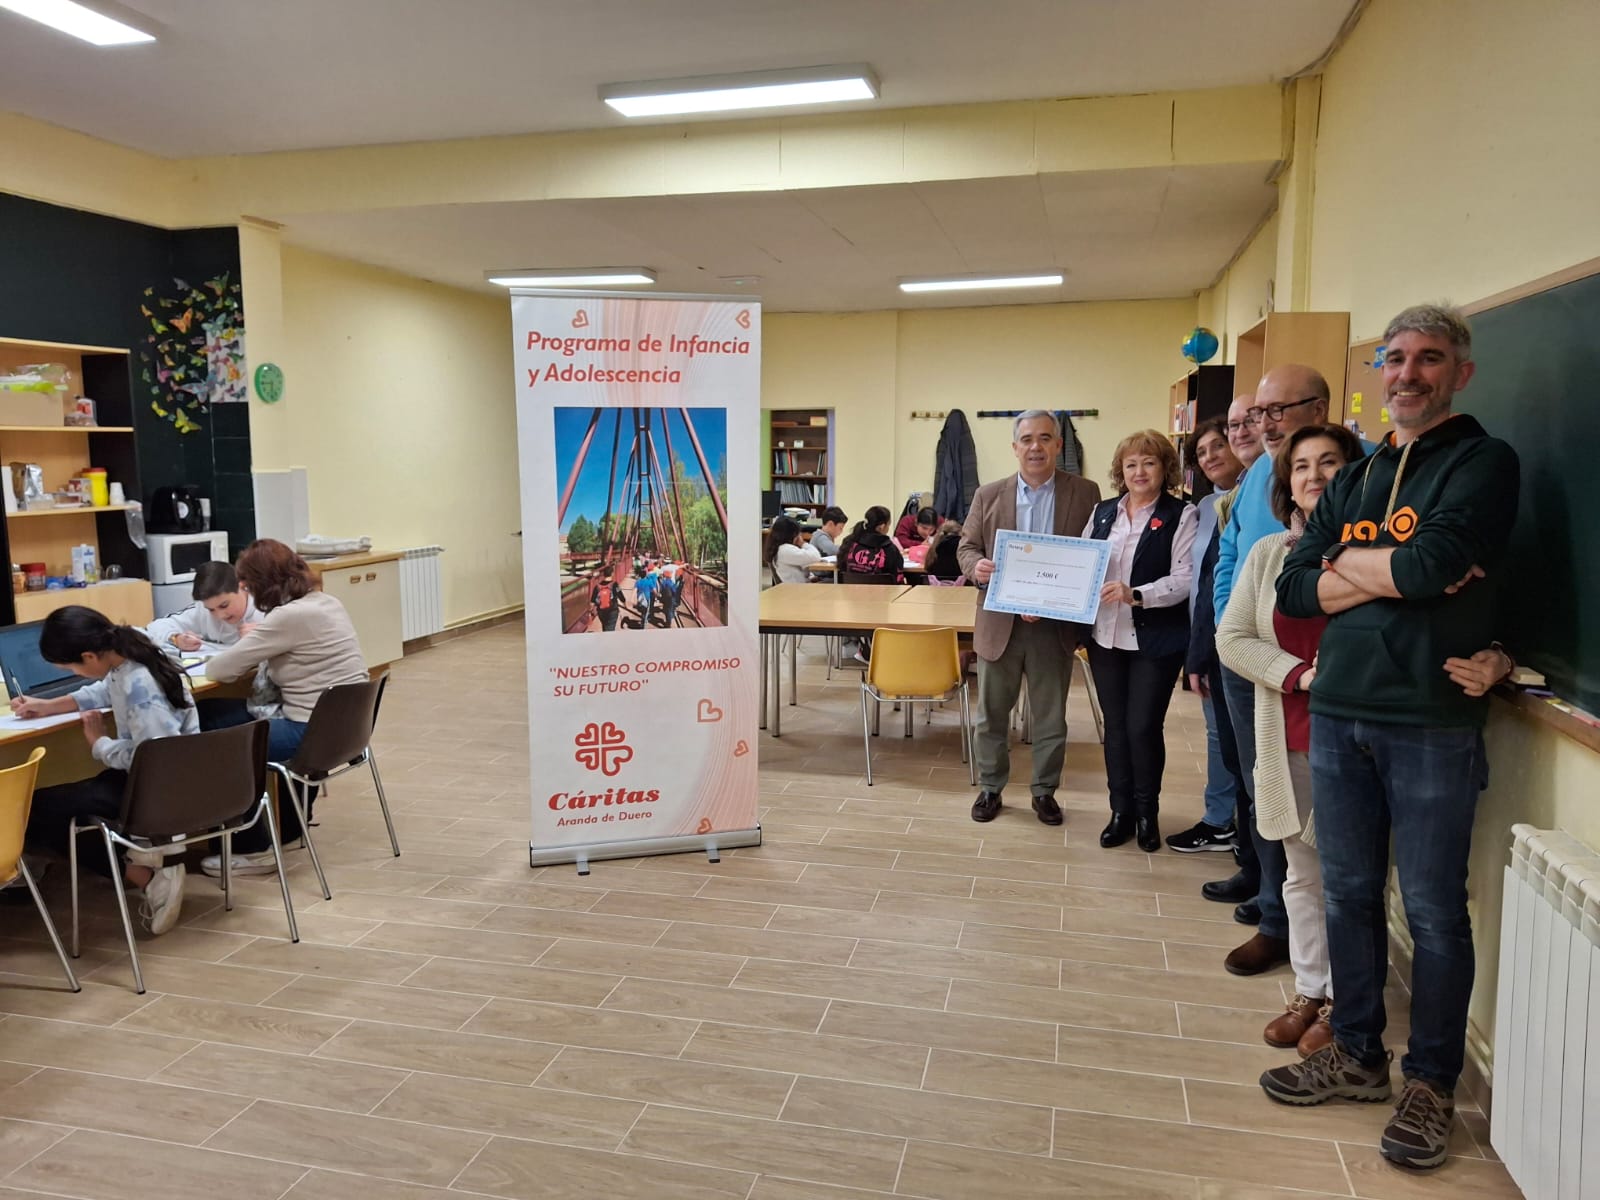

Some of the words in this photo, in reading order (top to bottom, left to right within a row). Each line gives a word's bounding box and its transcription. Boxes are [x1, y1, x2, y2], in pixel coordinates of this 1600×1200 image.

[527, 331, 631, 357] Programa
[637, 333, 662, 353] de
[669, 333, 750, 358] Infancia
[528, 368, 541, 388] y
[544, 362, 682, 384] Adolescencia
[549, 663, 631, 679] "NUESTRO
[635, 657, 741, 674] COMPROMISO
[553, 685, 575, 698] SU
[578, 678, 650, 696] FUTURO"
[548, 787, 661, 811] Cáritas
[556, 815, 599, 827] Aranda
[601, 813, 616, 823] de
[618, 810, 654, 822] Duero
